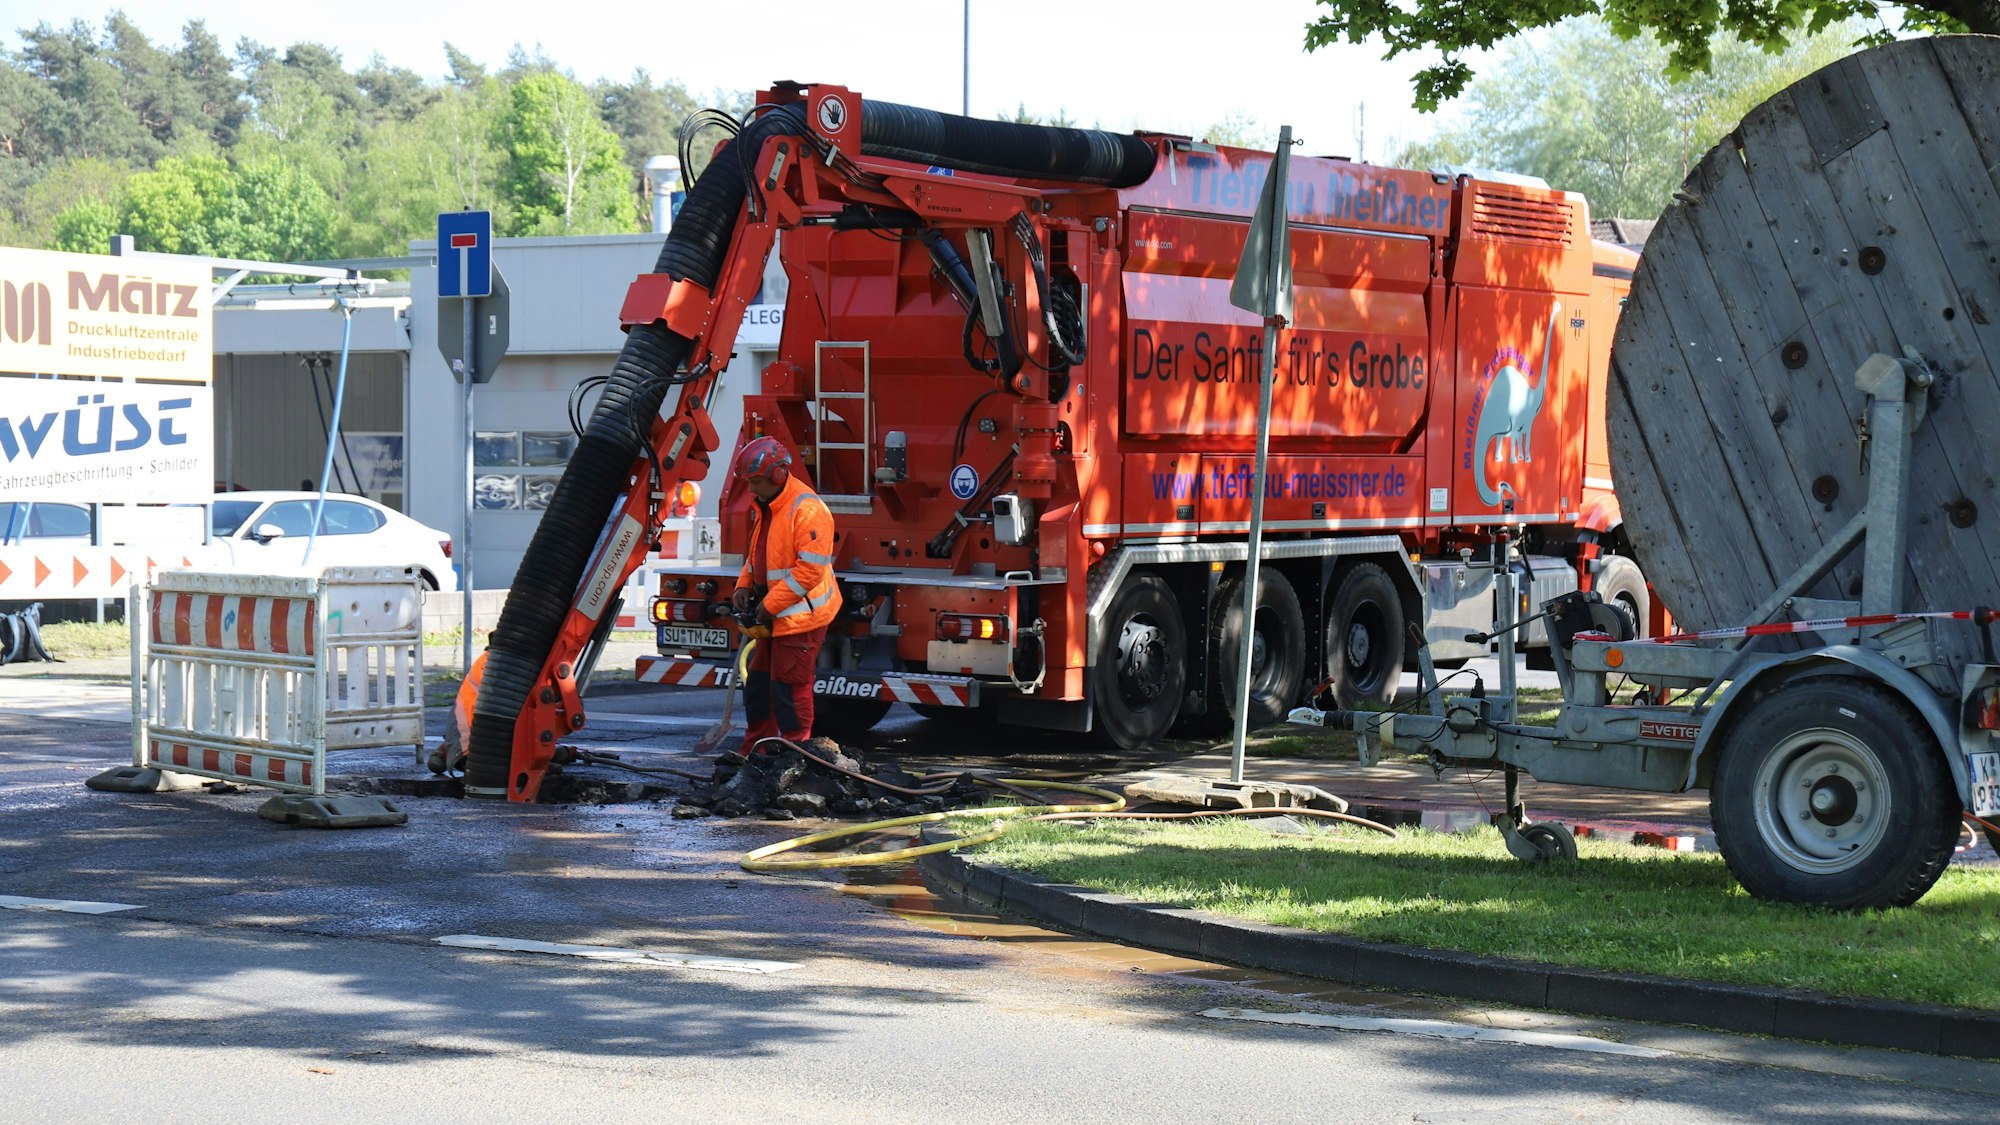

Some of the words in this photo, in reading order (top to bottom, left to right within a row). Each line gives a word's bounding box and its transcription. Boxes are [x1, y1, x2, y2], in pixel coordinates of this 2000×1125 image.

[1187, 155, 1313, 216] Tiefu
[1327, 171, 1450, 229] Meißner
[1135, 239, 1173, 250] www.p.com
[68, 270, 199, 318] März
[67, 321, 199, 342] Druckluftzentrale
[67, 343, 187, 363] Industriebedarf
[1133, 328, 1184, 381] Der
[1350, 340, 1425, 390] Grobe
[1463, 385, 1485, 470] Meißner
[150, 456, 198, 474] Schilder
[588, 530, 633, 607] www.rsp.com
[665, 628, 680, 643] SU
[688, 629, 703, 644] TM
[704, 631, 726, 645] 425
[813, 675, 883, 698] eißner
